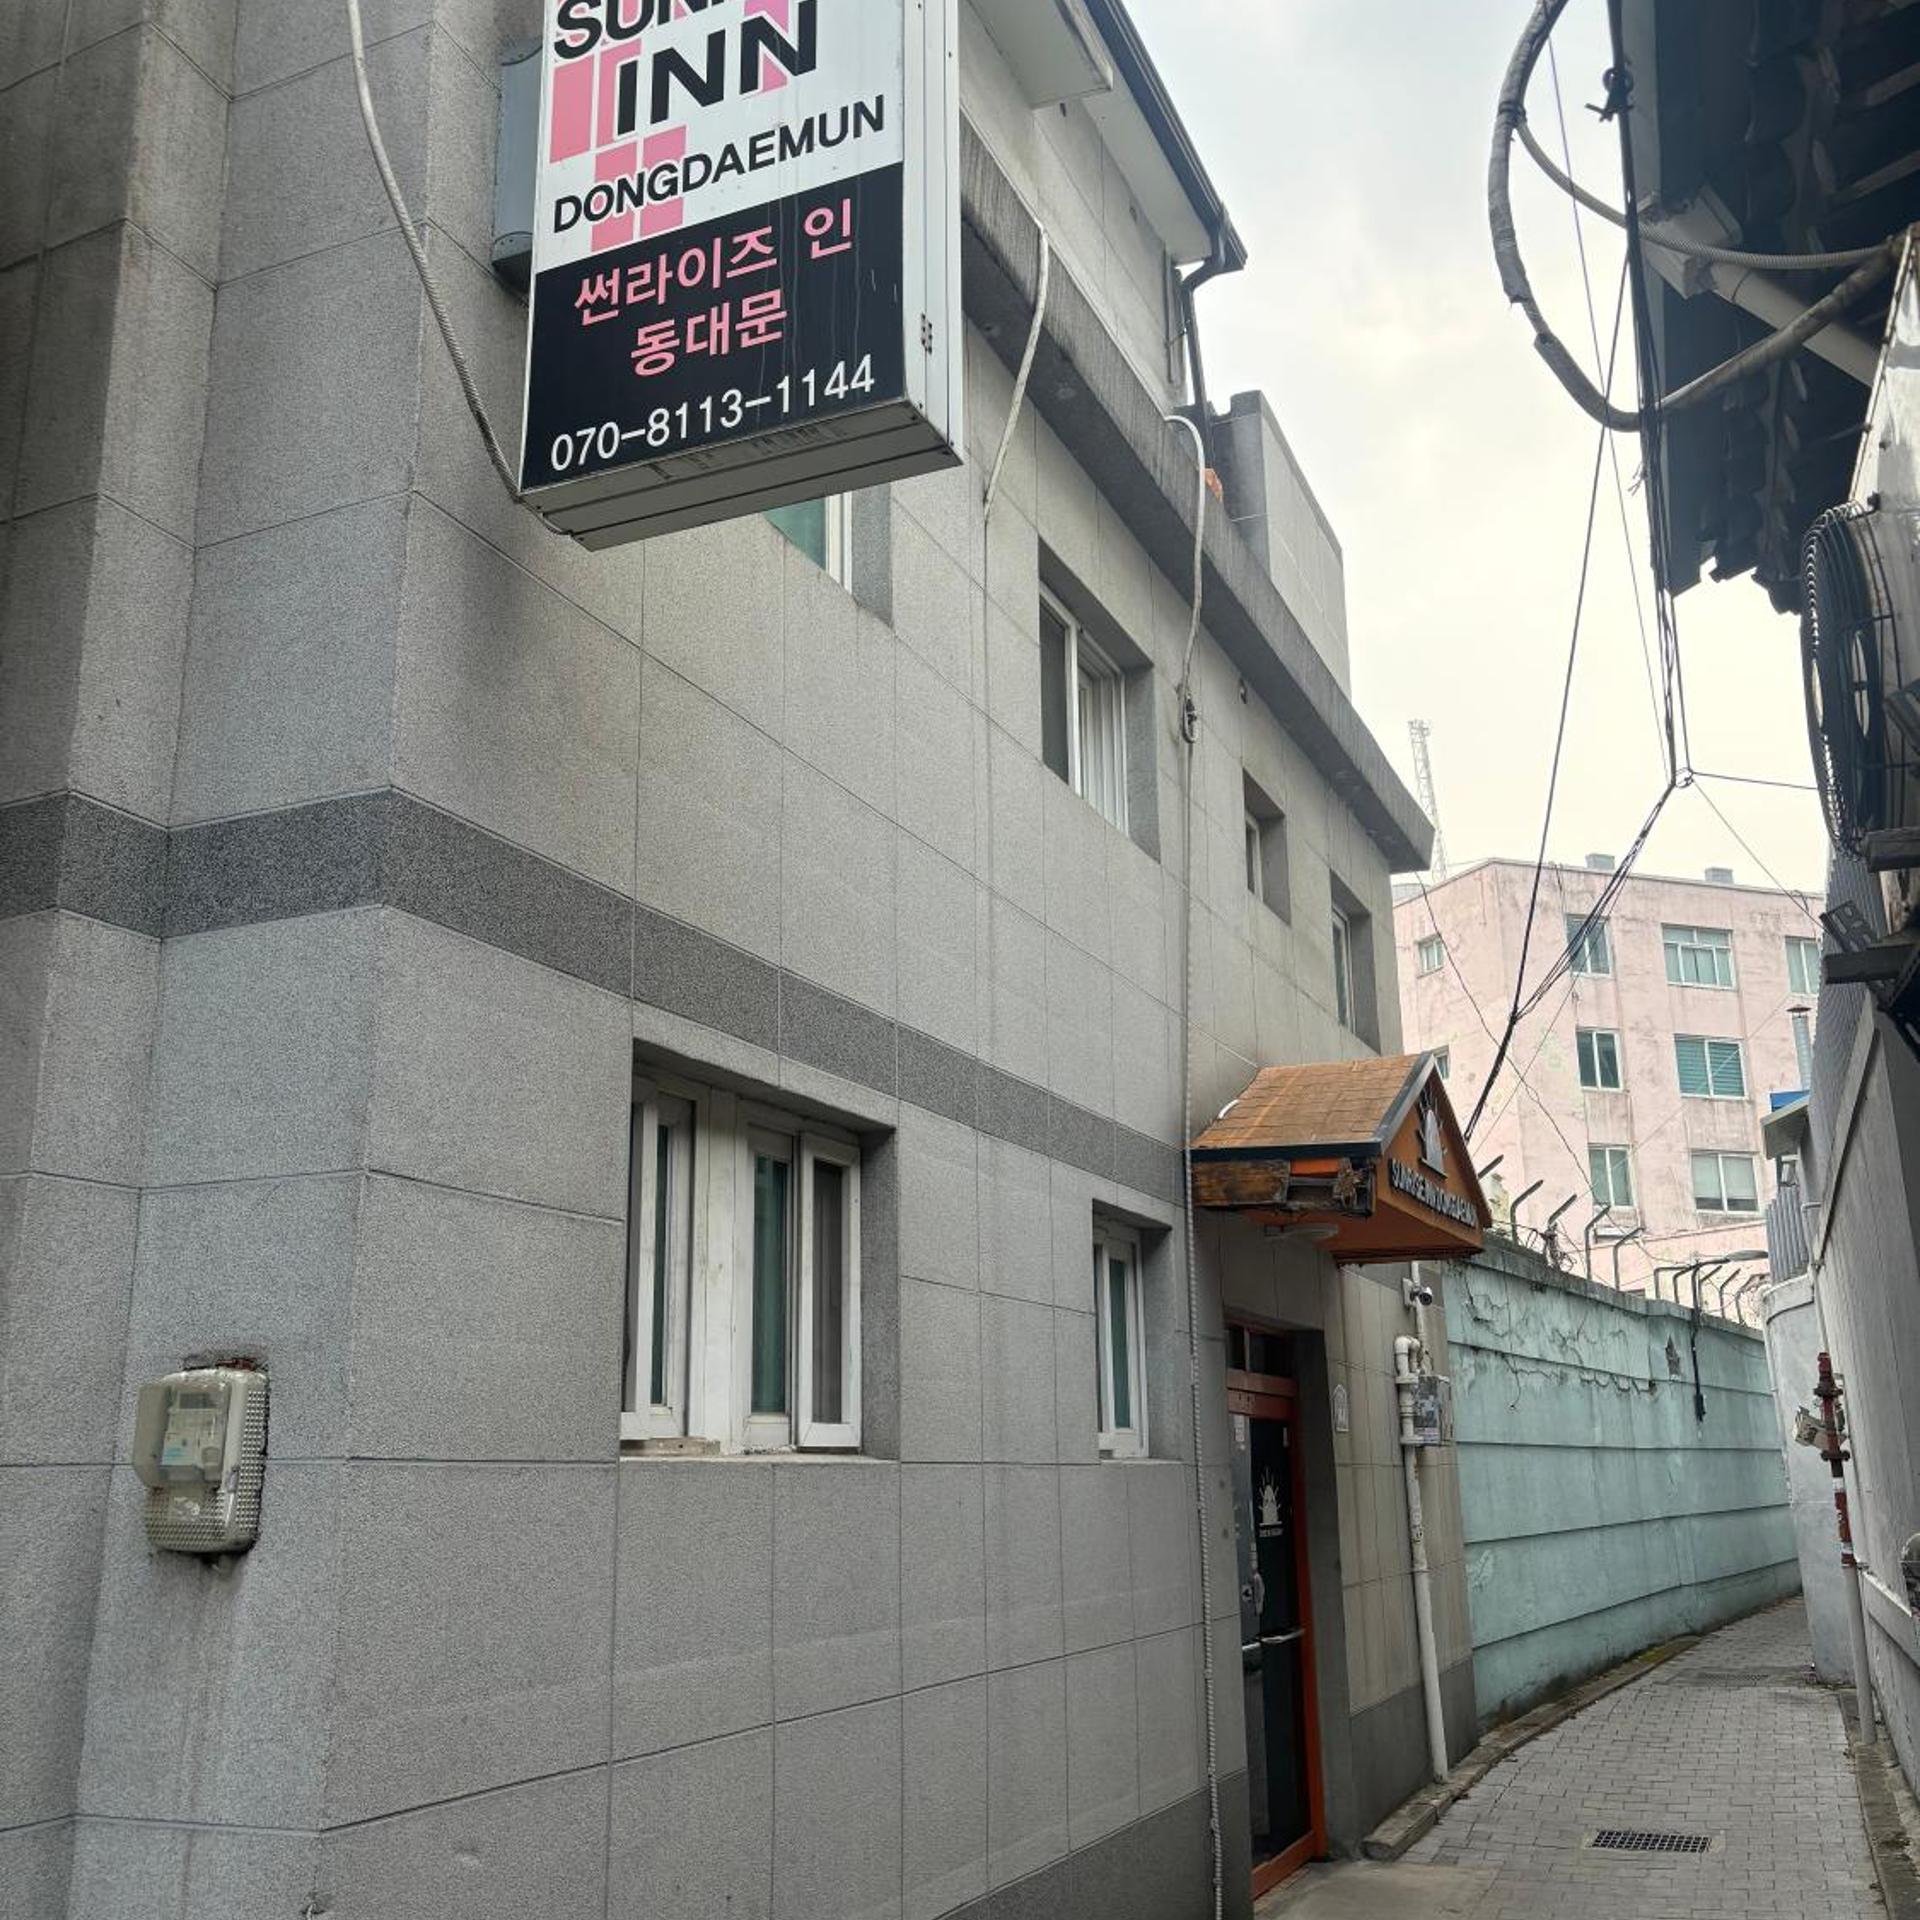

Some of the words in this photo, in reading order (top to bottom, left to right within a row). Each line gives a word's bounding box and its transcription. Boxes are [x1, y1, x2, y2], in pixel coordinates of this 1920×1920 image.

[617, 0, 818, 137] INN
[553, 94, 885, 233] DONGDAEMUN
[574, 224, 778, 327] 썬라이즈
[803, 197, 853, 260] 인
[630, 288, 788, 377] 동대문
[551, 353, 876, 471] 070-8113-1144
